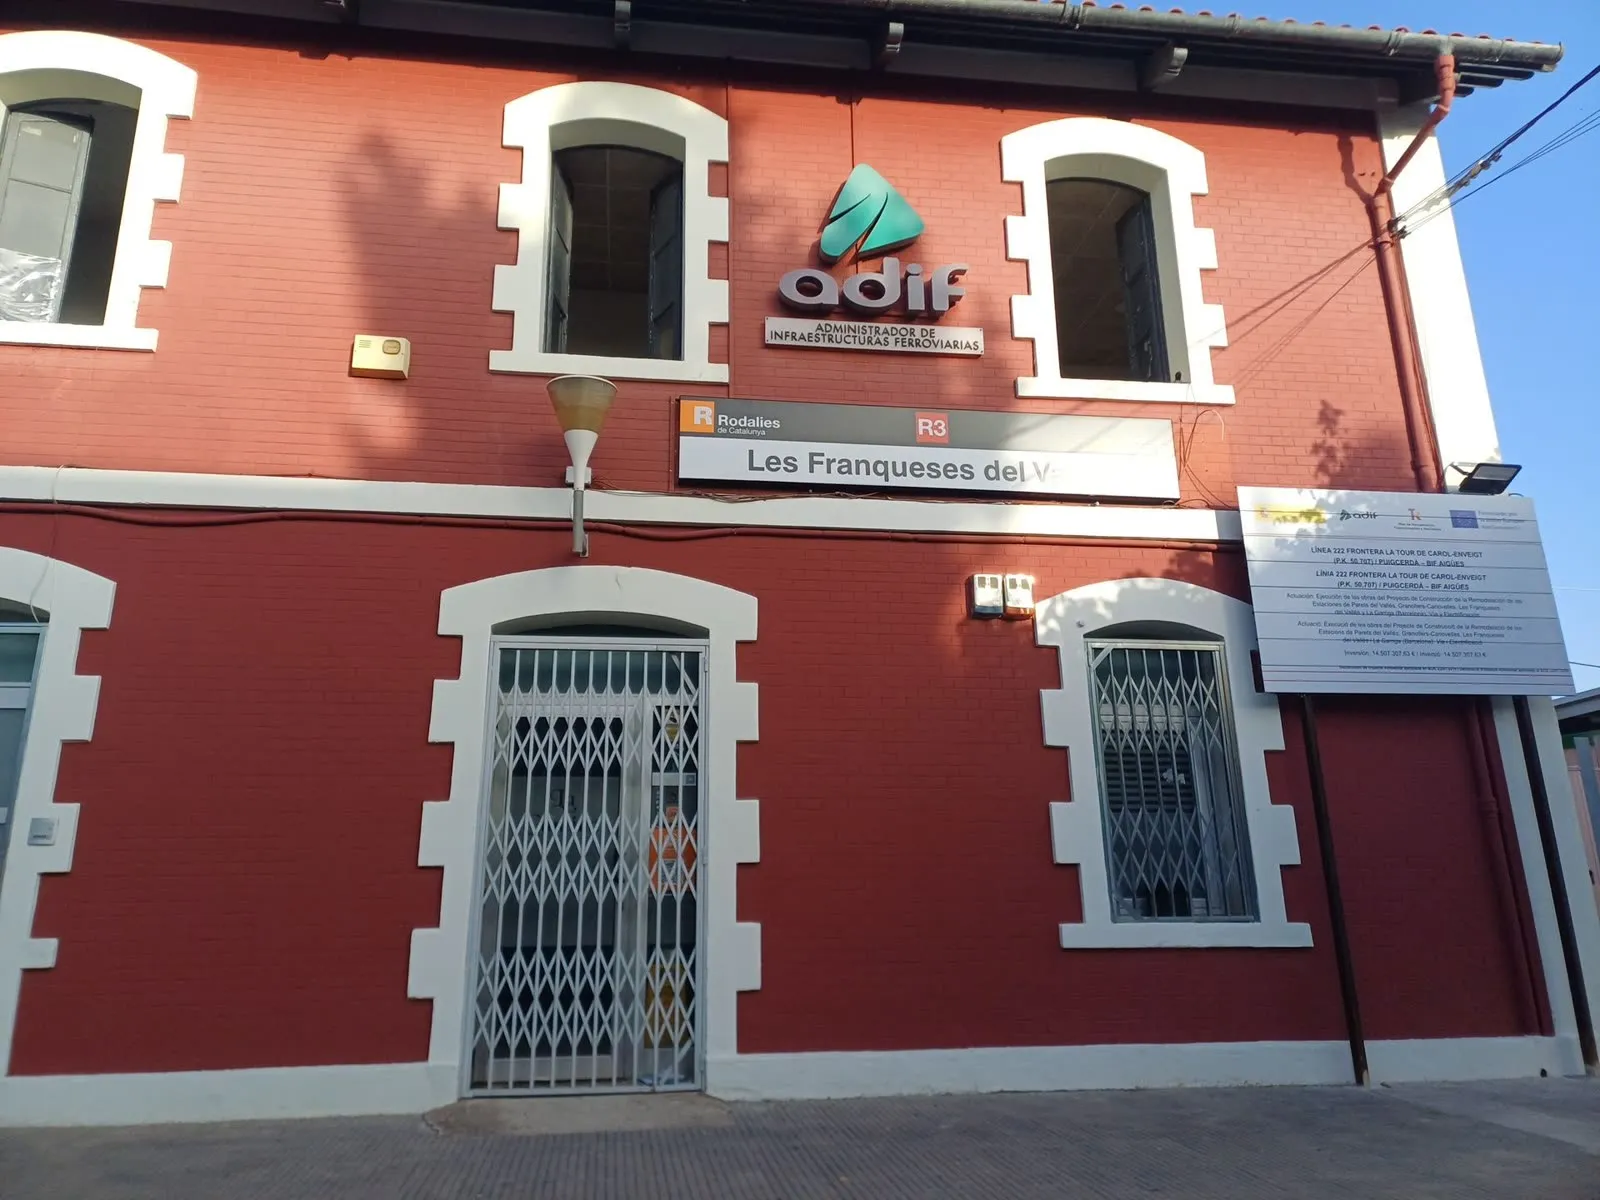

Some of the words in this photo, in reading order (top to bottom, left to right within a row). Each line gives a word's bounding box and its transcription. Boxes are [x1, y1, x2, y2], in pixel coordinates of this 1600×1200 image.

[779, 257, 969, 311] adif
[815, 323, 916, 338] ADMINISTRADOR
[920, 328, 936, 338] DE
[770, 330, 890, 347] INFRAESTRUCTURAS
[894, 338, 979, 351] FERROVIARIAS
[694, 406, 712, 425] R
[718, 414, 780, 429] Rodalies
[728, 427, 766, 436] Catalunya
[918, 418, 947, 437] R3
[748, 449, 799, 473] Les
[808, 452, 975, 482] Franqueses
[984, 460, 1025, 482] del
[1311, 546, 1332, 554] LÍNEA
[1428, 550, 1483, 558] CAROL-ENVEIGT
[1431, 573, 1486, 581] CAROL-ENVEIGT
[1354, 581, 1377, 589] 50.707)
